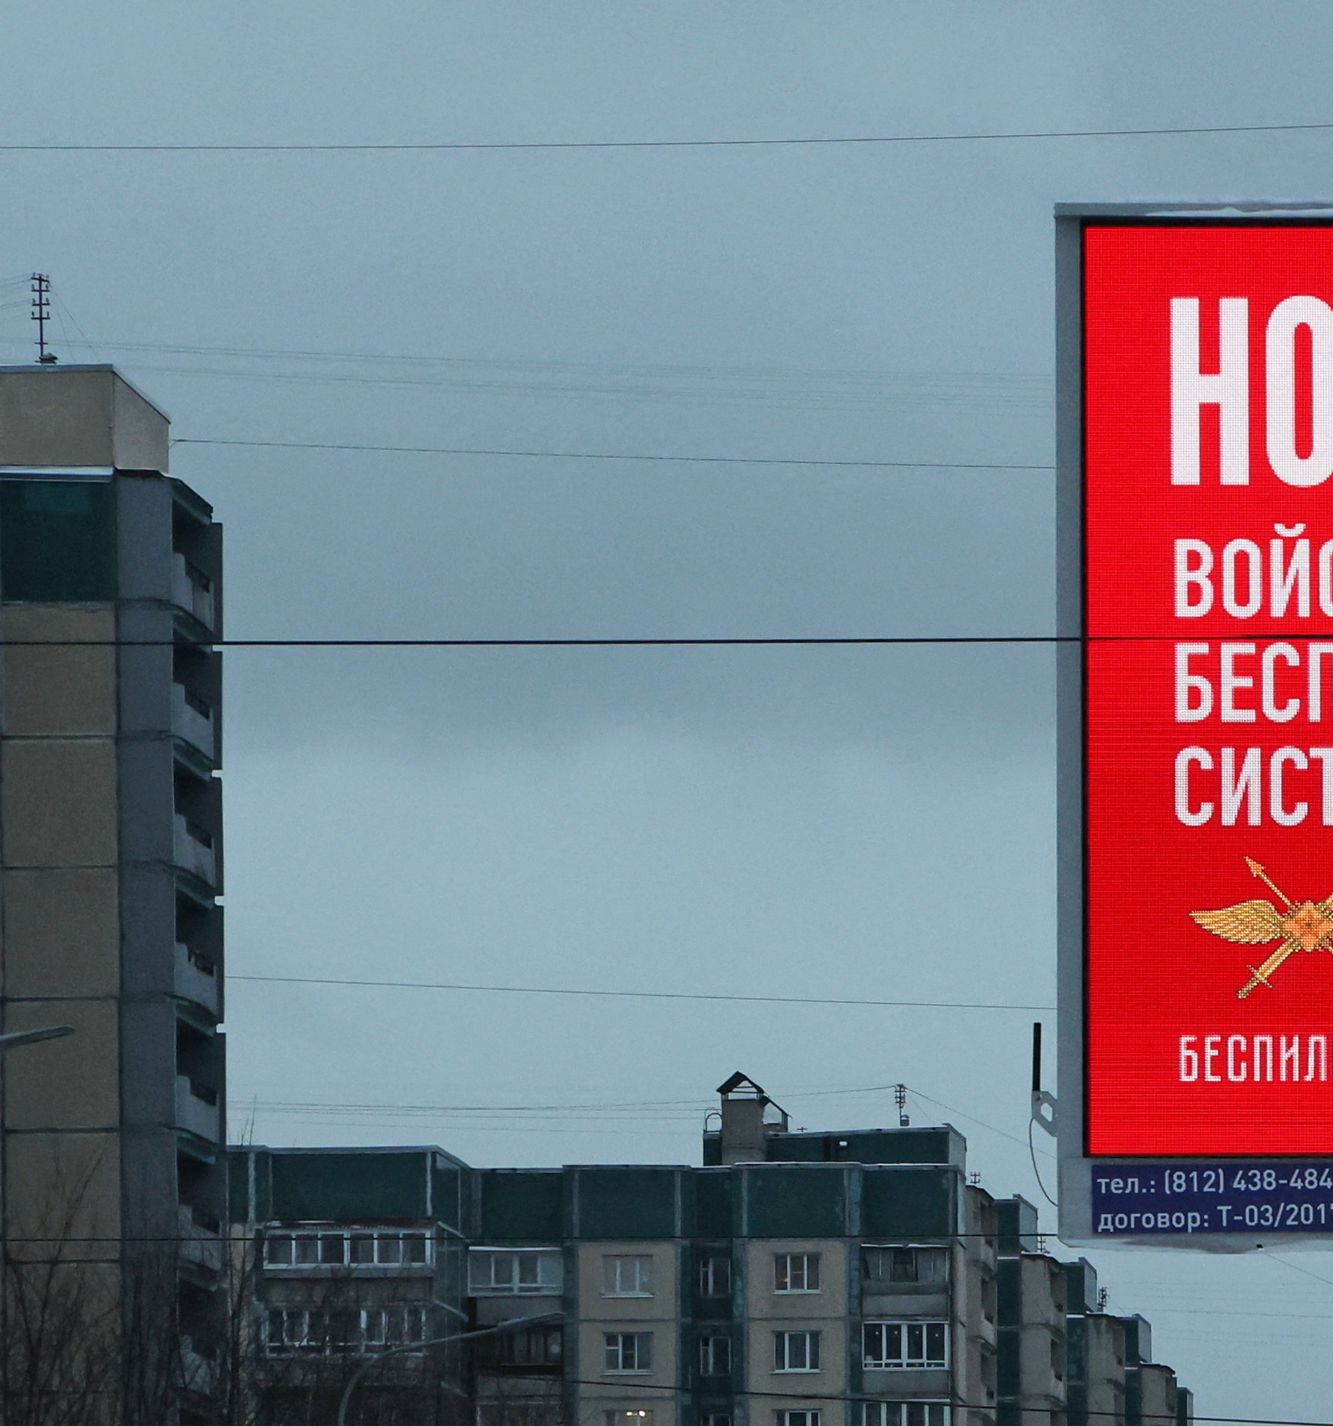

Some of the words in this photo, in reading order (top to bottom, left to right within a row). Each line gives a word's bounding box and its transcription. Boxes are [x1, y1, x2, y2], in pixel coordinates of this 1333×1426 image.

[1097, 1175, 1156, 1194] тел.:
[1164, 1167, 1224, 1195] (812)
[1097, 1209, 1209, 1234] договор:
